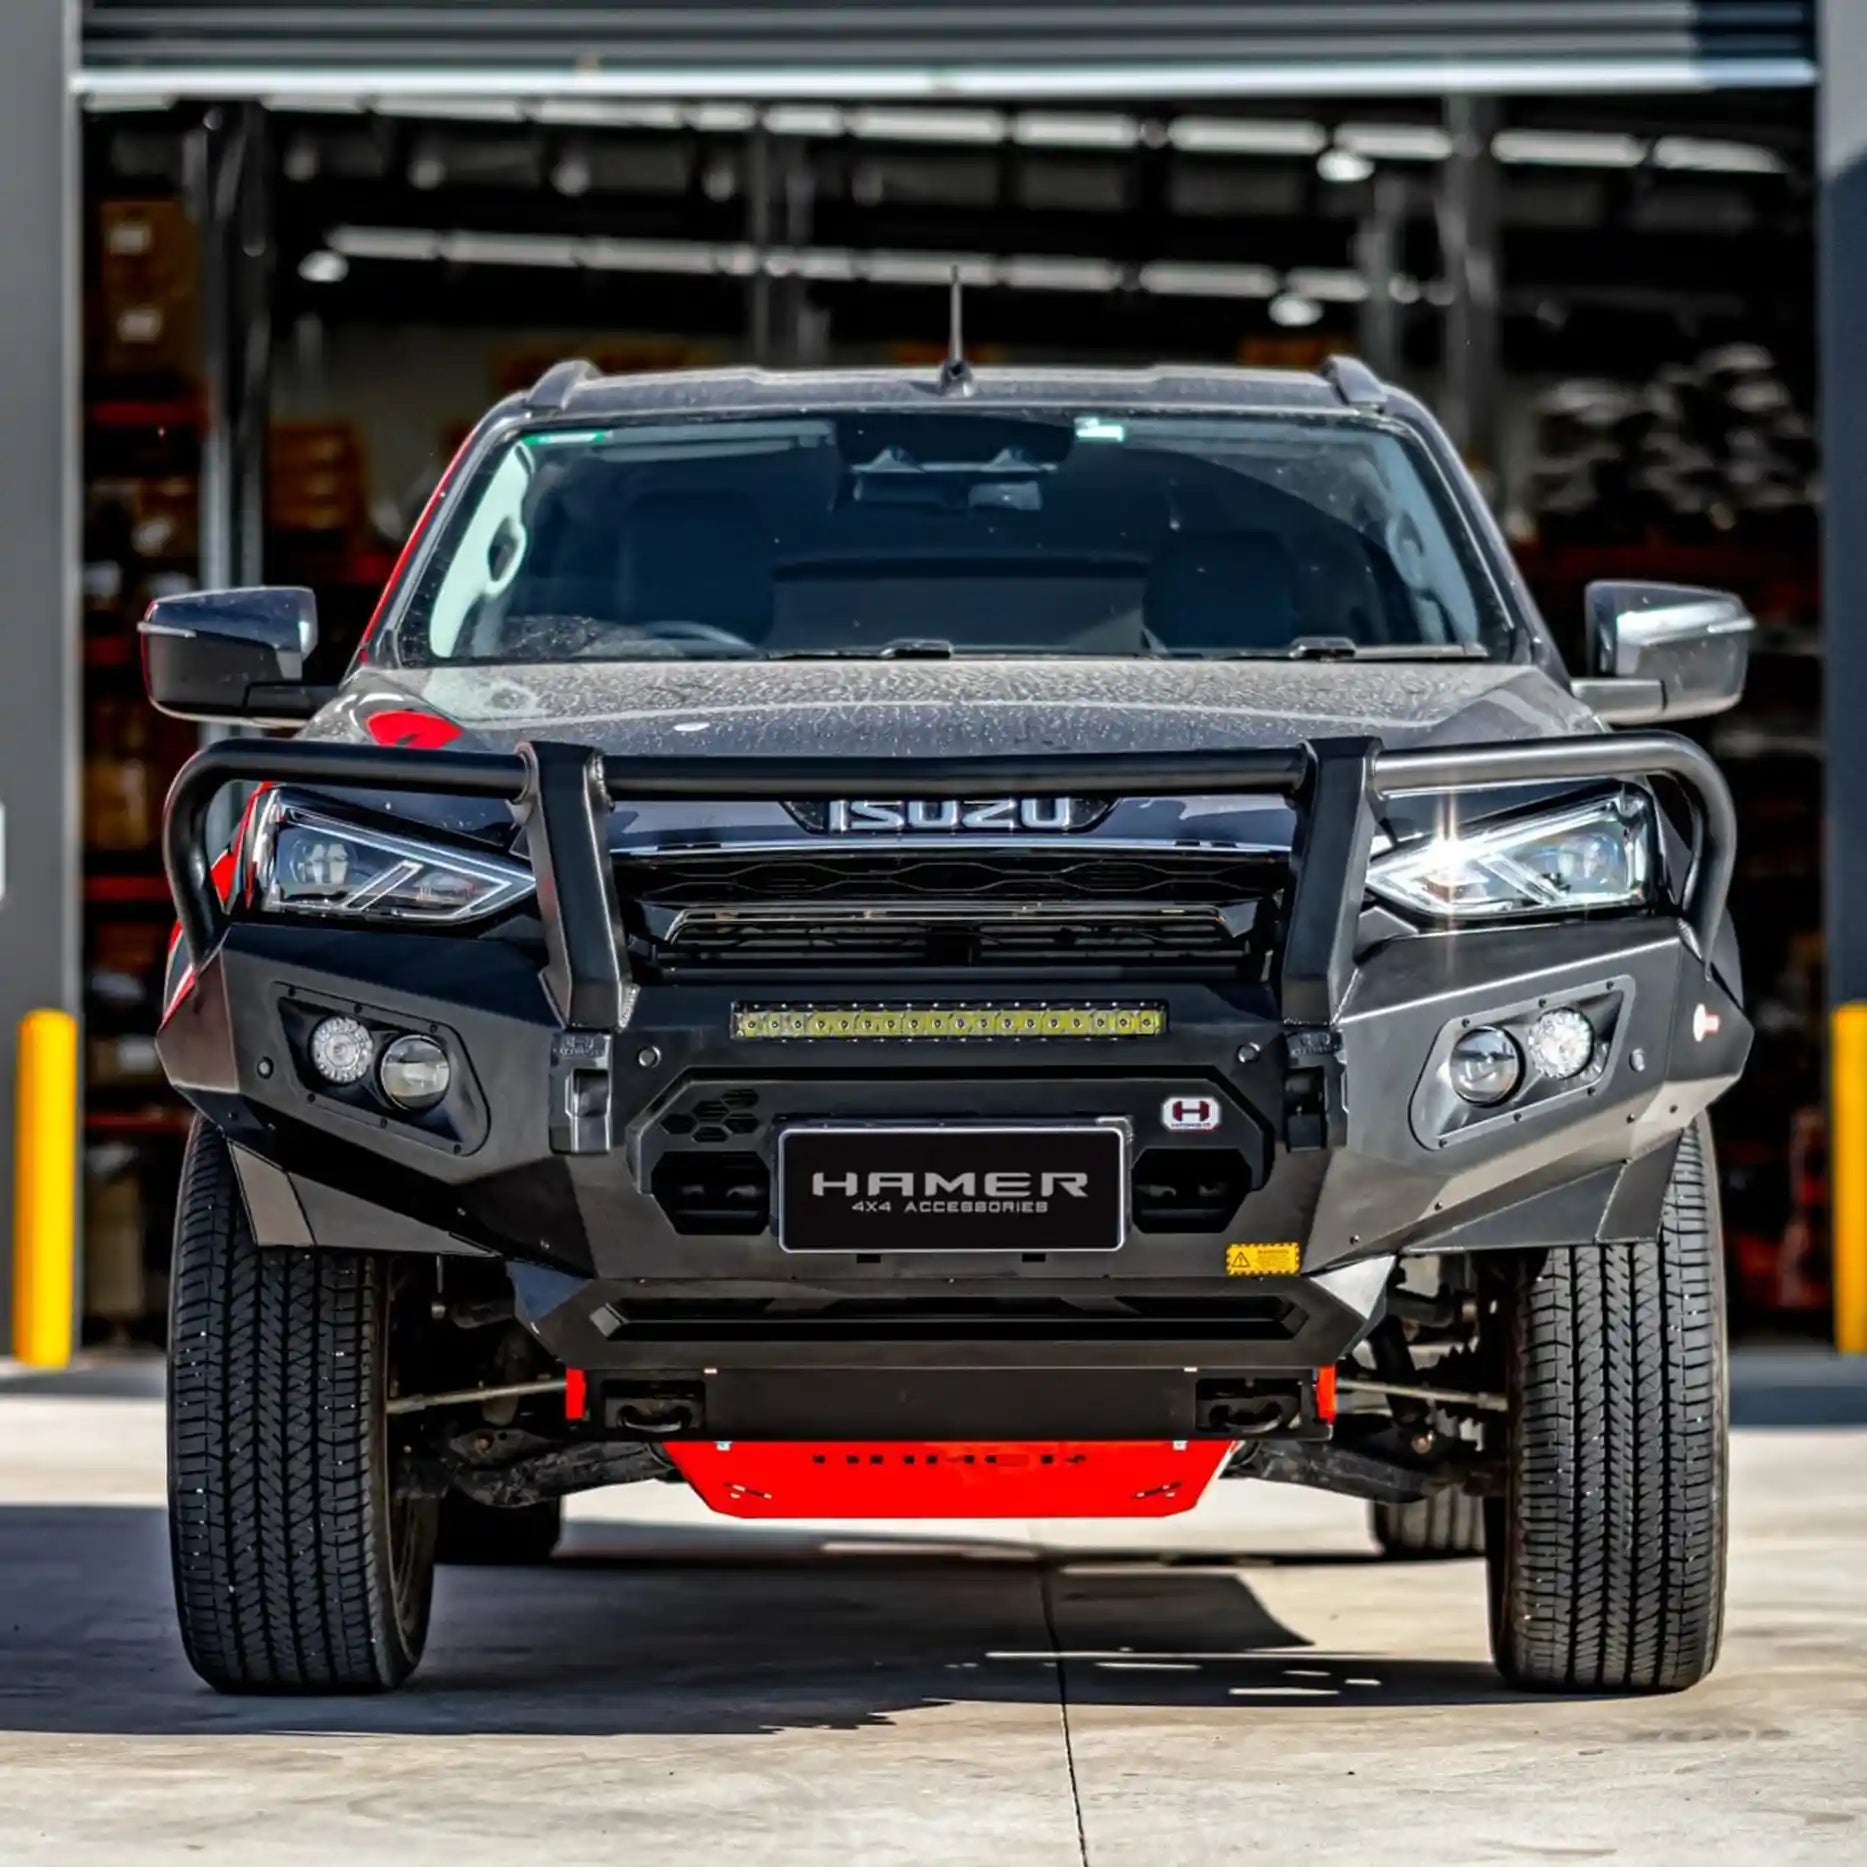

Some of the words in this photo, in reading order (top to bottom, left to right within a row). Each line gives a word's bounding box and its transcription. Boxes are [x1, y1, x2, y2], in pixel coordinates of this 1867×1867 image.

[829, 799, 1071, 832] ISUZU
[812, 1172, 1088, 1197] HAMER
[904, 1201, 1048, 1213] ACCESSORIES
